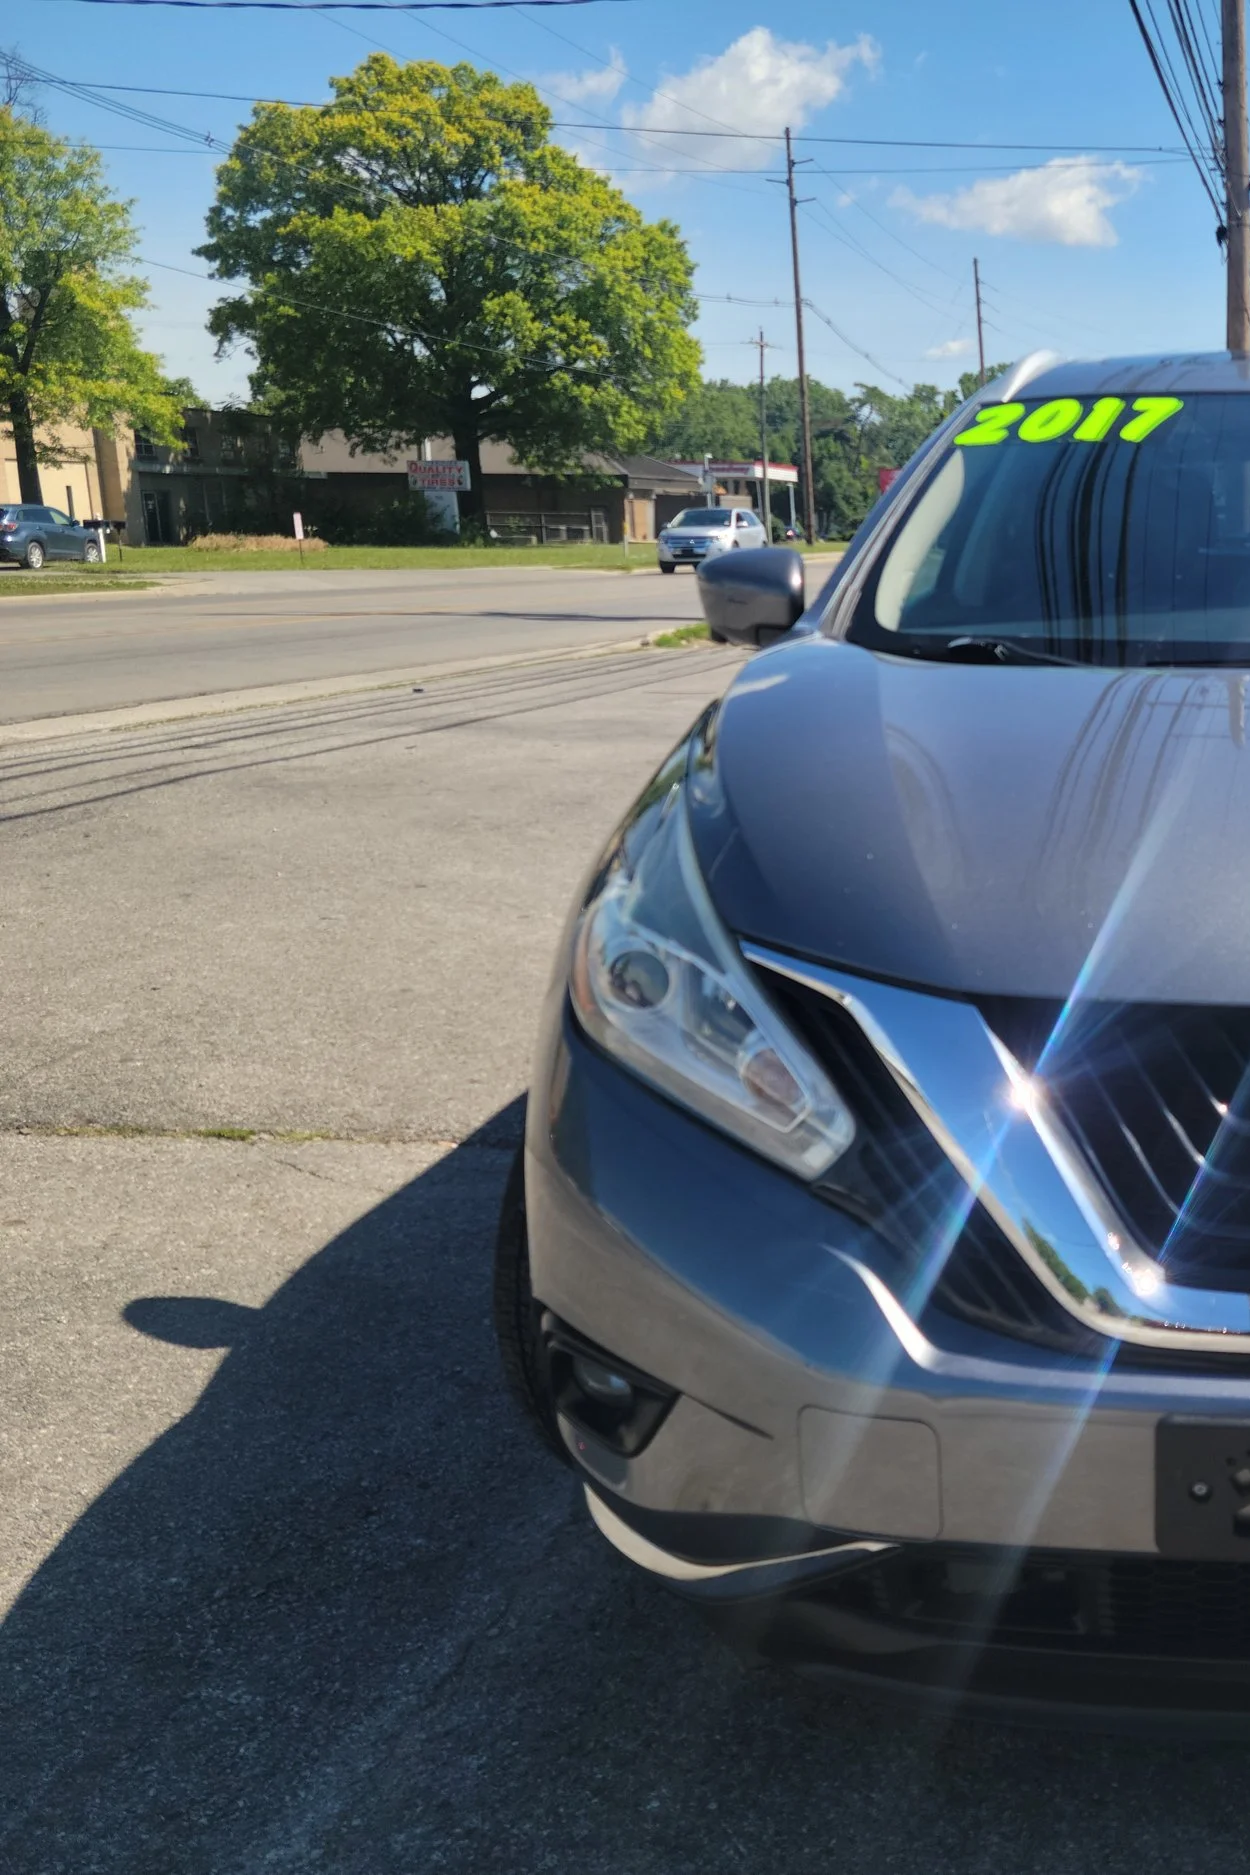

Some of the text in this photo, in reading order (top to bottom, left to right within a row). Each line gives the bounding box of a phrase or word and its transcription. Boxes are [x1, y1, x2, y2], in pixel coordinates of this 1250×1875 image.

[953, 397, 1184, 446] 2017
[409, 462, 464, 473] QUALITY
[419, 478, 455, 486] TIRES
